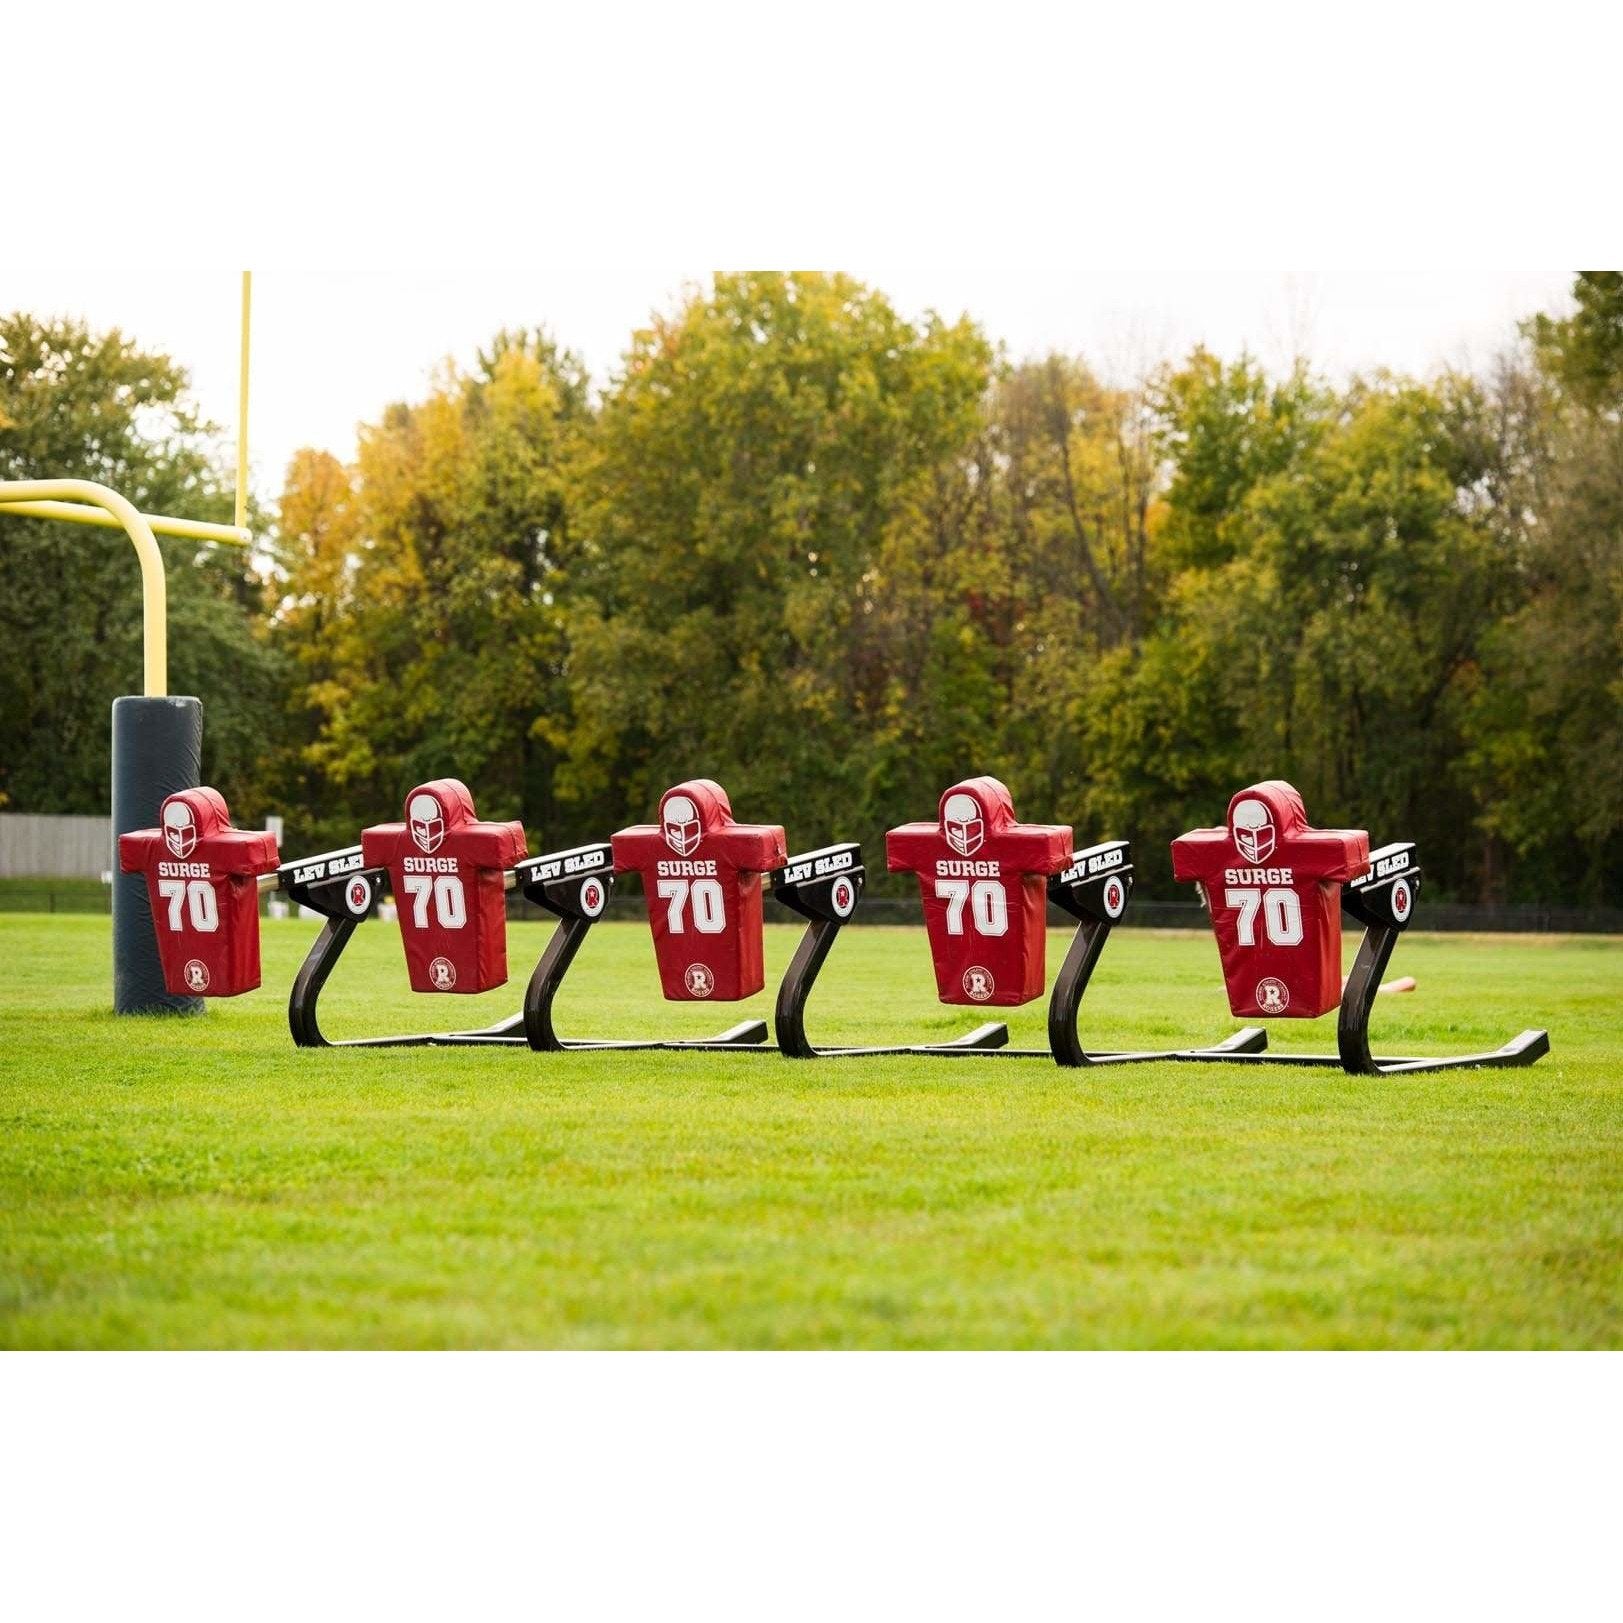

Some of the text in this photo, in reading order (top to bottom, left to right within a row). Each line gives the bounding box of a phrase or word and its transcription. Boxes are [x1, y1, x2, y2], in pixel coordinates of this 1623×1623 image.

[158, 862, 211, 879] SURGE
[293, 853, 364, 884] LEV SLE
[403, 857, 459, 873] SURGE
[530, 850, 605, 882] LEV SLED
[656, 860, 718, 877] SURGE
[783, 851, 853, 884] LEV SLED
[935, 860, 1001, 877] SURGE
[1088, 849, 1123, 874] SLED
[1224, 868, 1294, 885] SURGE
[1376, 851, 1410, 877] SLED
[158, 880, 220, 933] 70
[403, 875, 468, 929] 70
[656, 879, 727, 934] 70
[934, 879, 1009, 937] 70
[1224, 888, 1304, 946] 70
